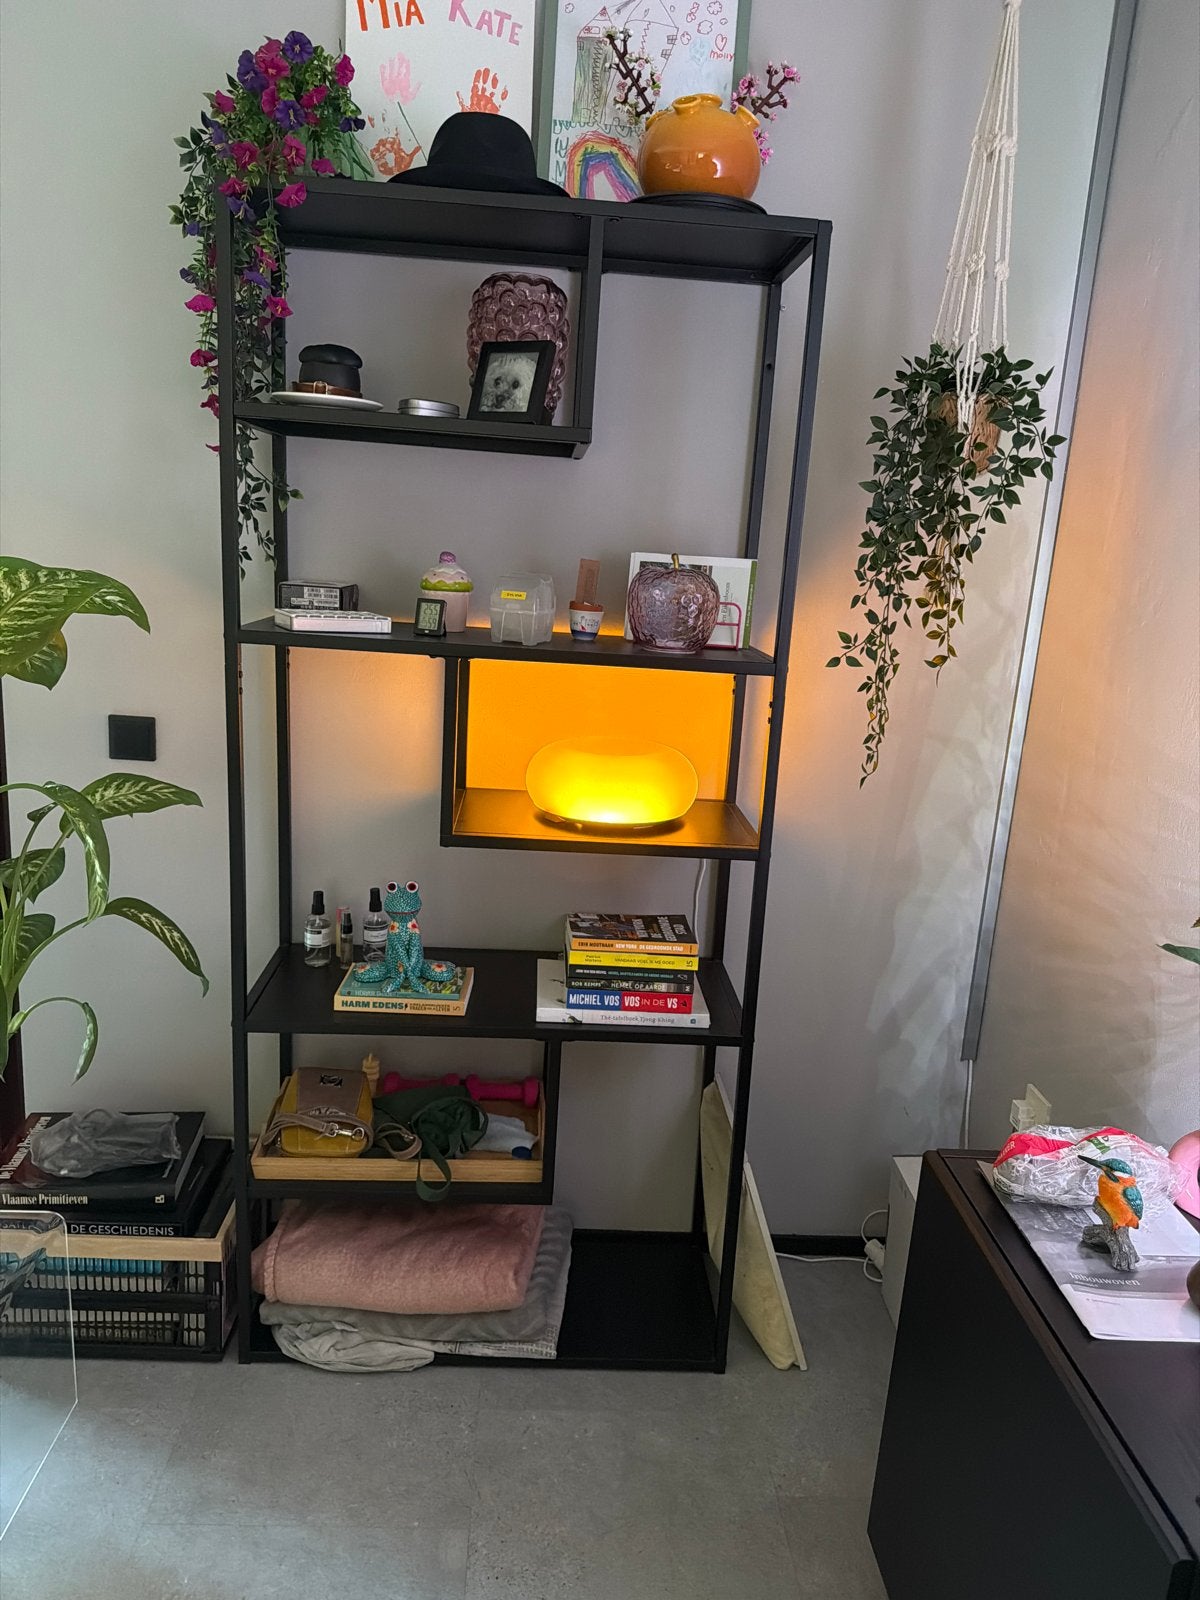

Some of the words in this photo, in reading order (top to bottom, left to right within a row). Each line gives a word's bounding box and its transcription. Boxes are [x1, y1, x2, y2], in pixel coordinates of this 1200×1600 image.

[448, 0, 523, 46] KATE
[611, 981, 633, 989] HEMEL
[341, 1000, 370, 1008] HARM
[372, 1001, 405, 1010] EDENS
[569, 993, 602, 1006] MICHIEL
[604, 995, 620, 1007] VOS
[624, 995, 640, 1007] VOS
[667, 997, 678, 1009] VS
[1, 1193, 37, 1205] Vlaamse
[38, 1193, 89, 1205] Primitieven
[70, 1223, 87, 1235] DE
[88, 1224, 175, 1237] GESCHIEDENIS
[1068, 1271, 1141, 1287] Inbouwoven
